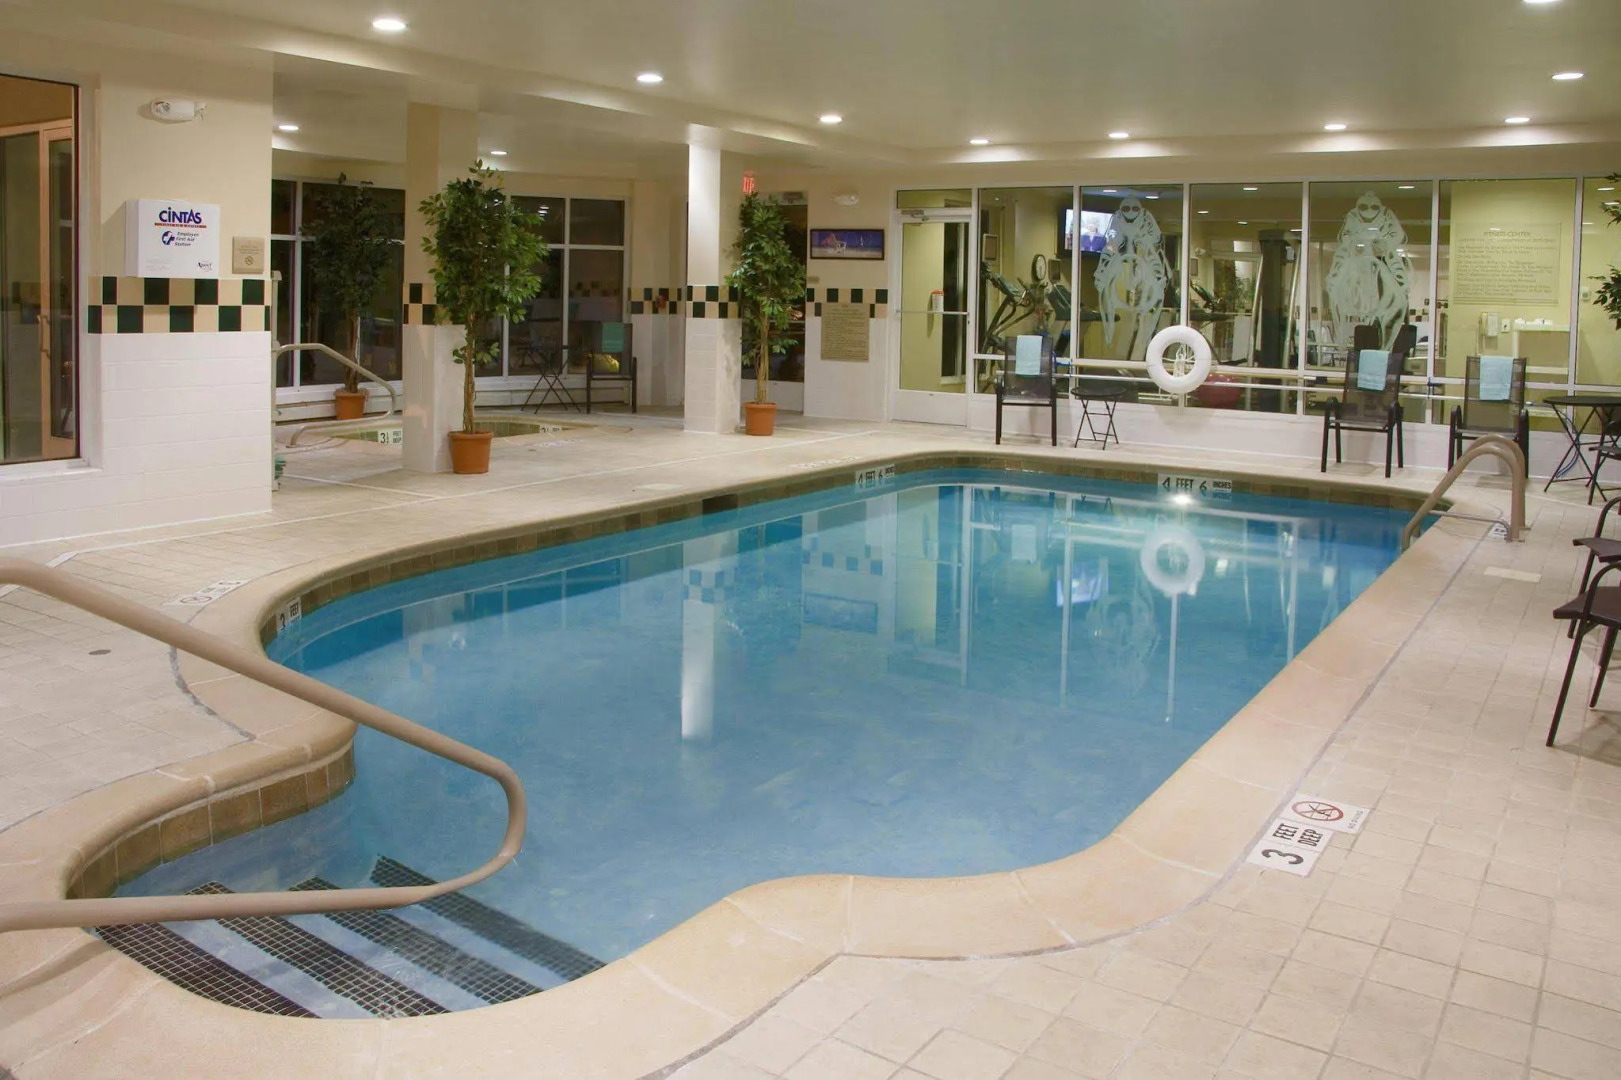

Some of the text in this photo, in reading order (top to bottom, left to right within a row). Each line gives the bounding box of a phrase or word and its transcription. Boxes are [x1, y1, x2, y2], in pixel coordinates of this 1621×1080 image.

[1175, 478, 1195, 488] FEET
[1199, 480, 1208, 491] 6
[1272, 822, 1299, 841] FEET
[1297, 828, 1323, 847] DEEP
[1261, 848, 1304, 865] 3
